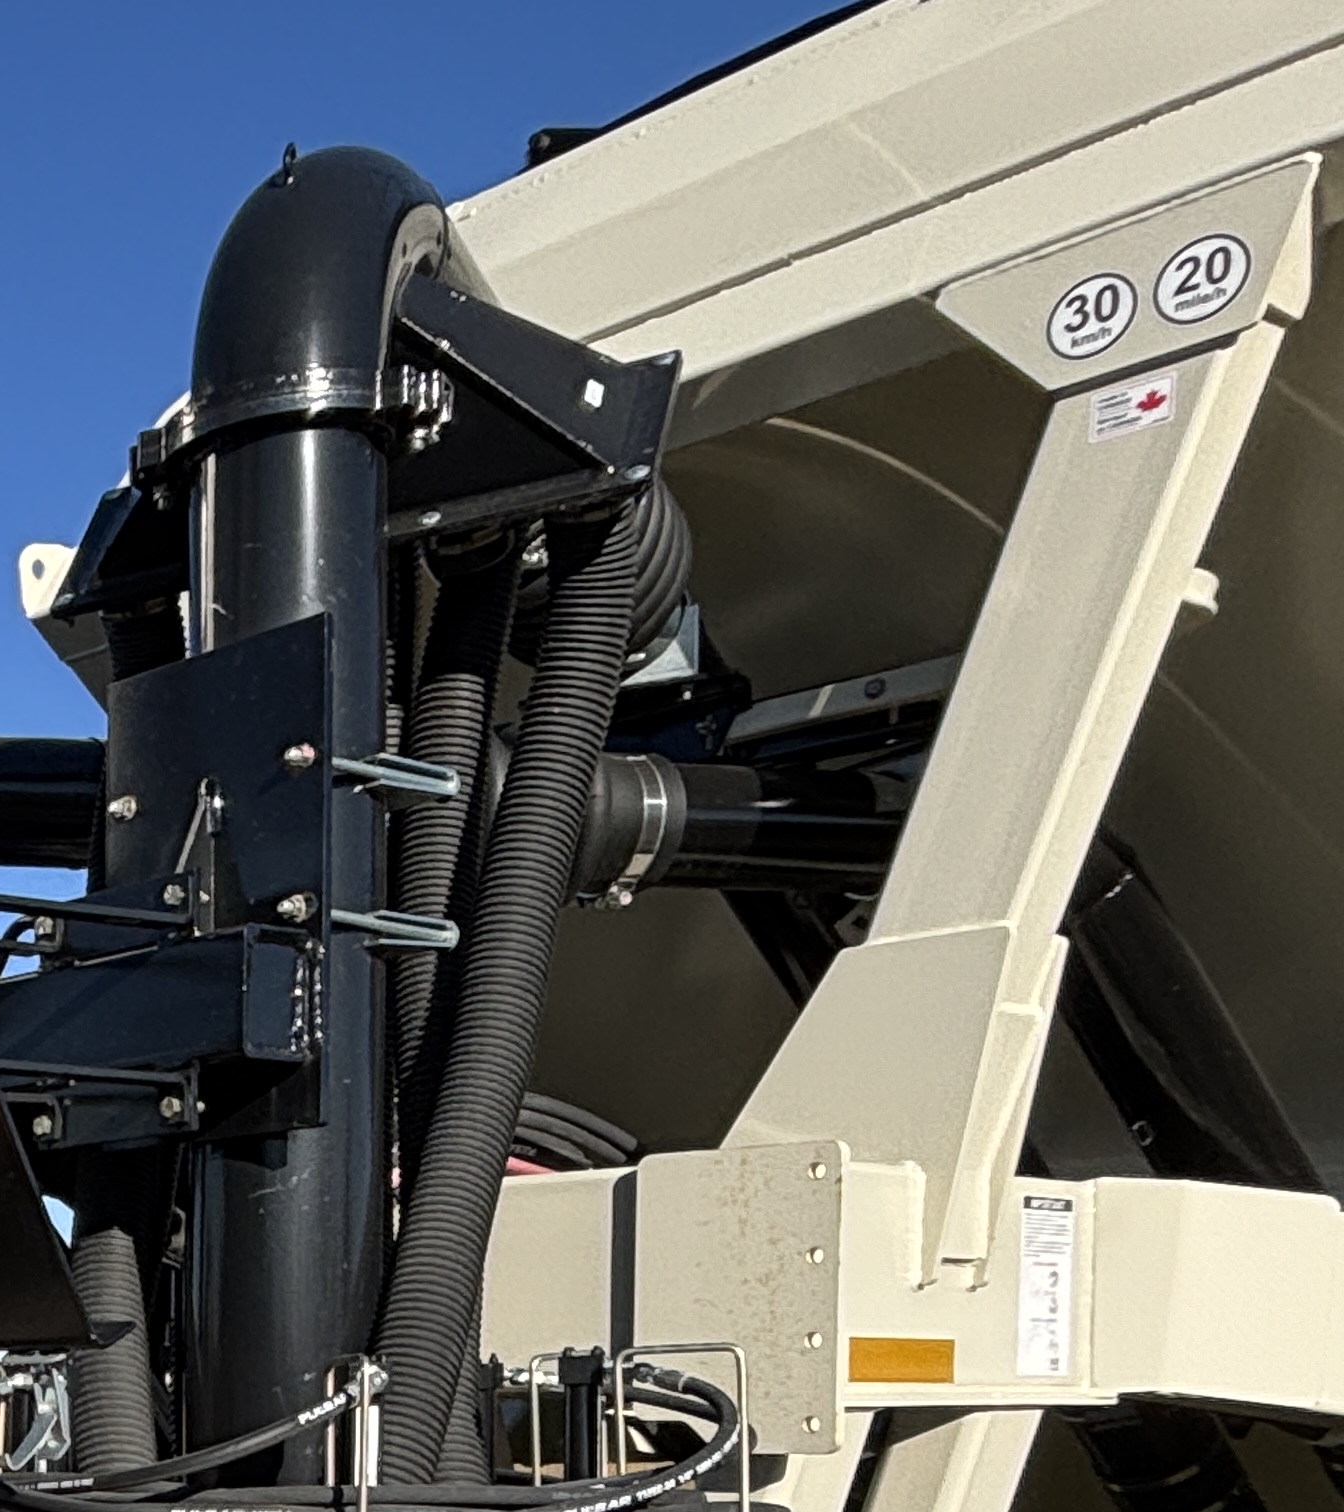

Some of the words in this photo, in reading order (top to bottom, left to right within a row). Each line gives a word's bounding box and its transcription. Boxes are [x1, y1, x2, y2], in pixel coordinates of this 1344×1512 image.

[1172, 246, 1233, 297] 20
[1063, 284, 1120, 334] 30
[1070, 326, 1113, 349] km/h
